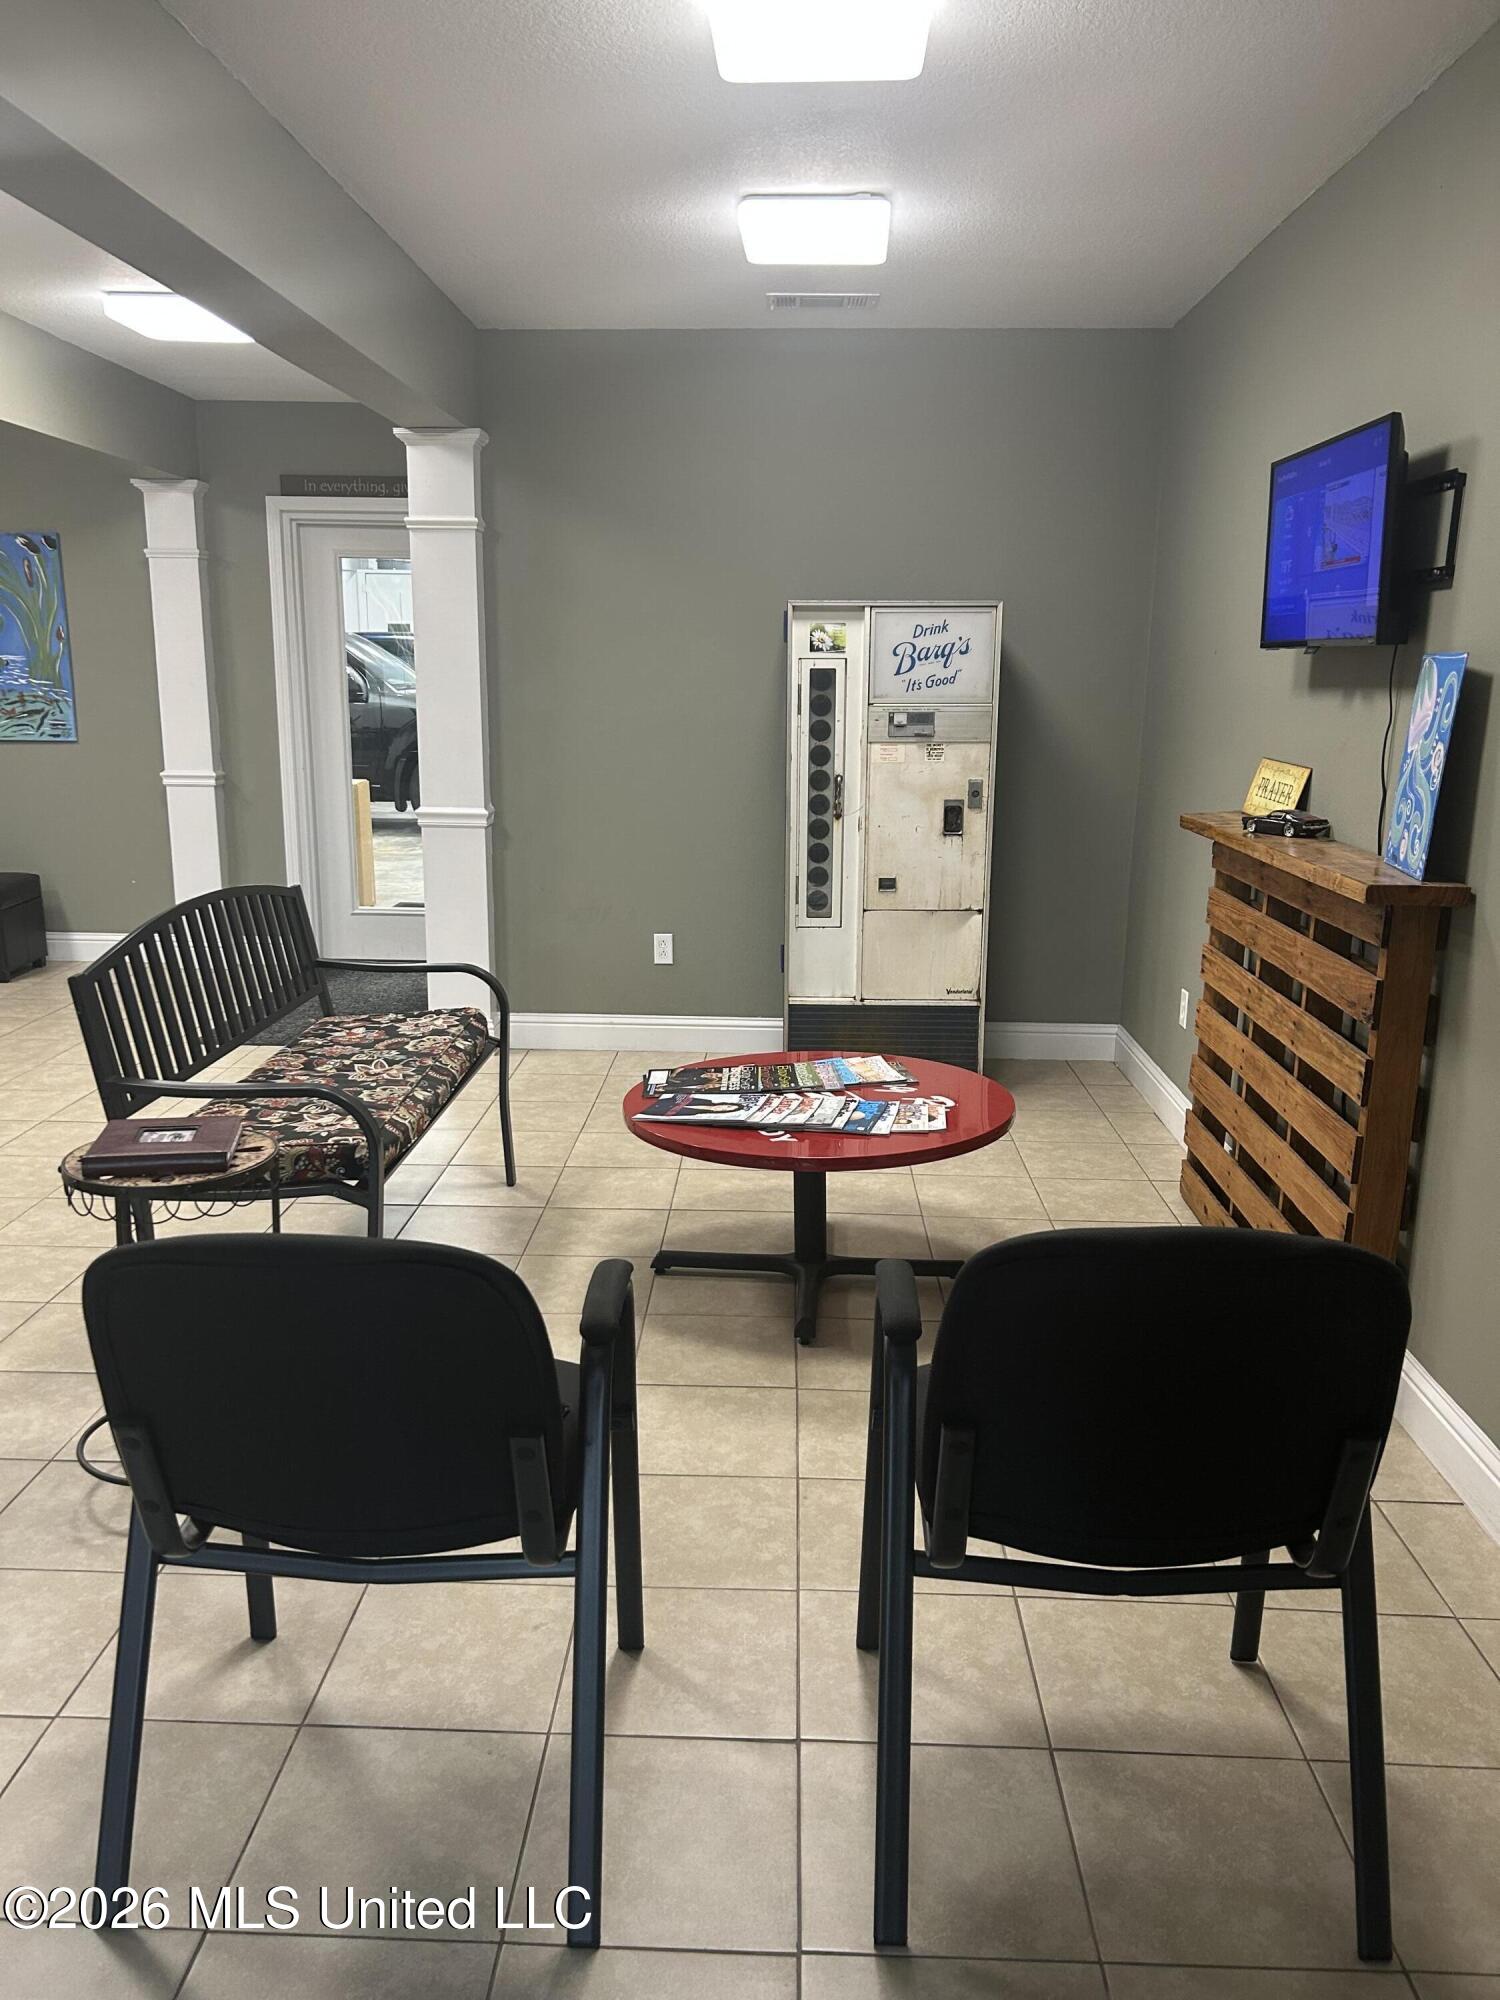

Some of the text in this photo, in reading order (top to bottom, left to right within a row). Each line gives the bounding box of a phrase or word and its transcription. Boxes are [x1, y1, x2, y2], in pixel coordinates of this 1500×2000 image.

[304, 479, 316, 492] In
[320, 478, 389, 496] everything,
[913, 619, 949, 639] Drink
[892, 637, 972, 676] Barq's
[1255, 777, 1294, 806] PRAYER
